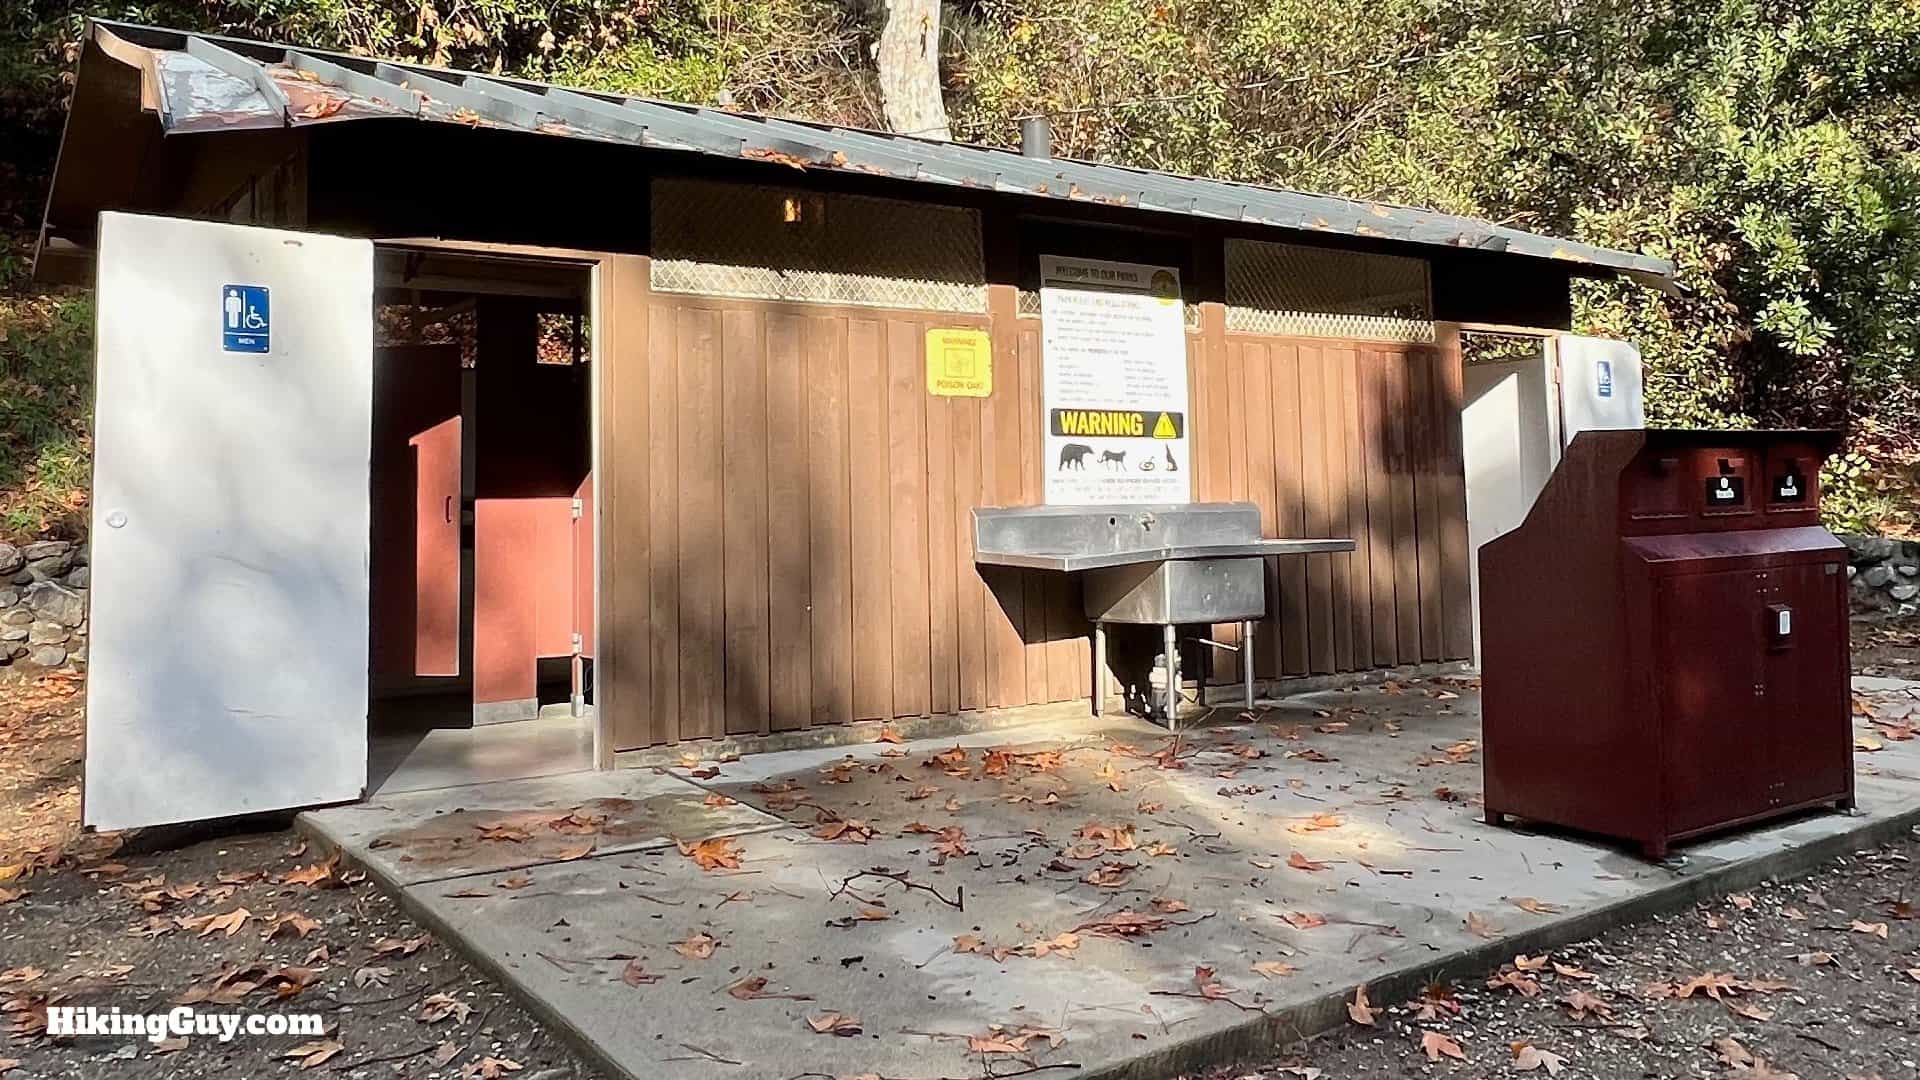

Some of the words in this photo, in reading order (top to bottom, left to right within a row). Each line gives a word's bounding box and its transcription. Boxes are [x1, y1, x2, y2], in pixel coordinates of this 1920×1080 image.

[238, 337, 255, 345] MEN
[936, 379, 964, 389] POISON
[1060, 410, 1144, 436] WARNING
